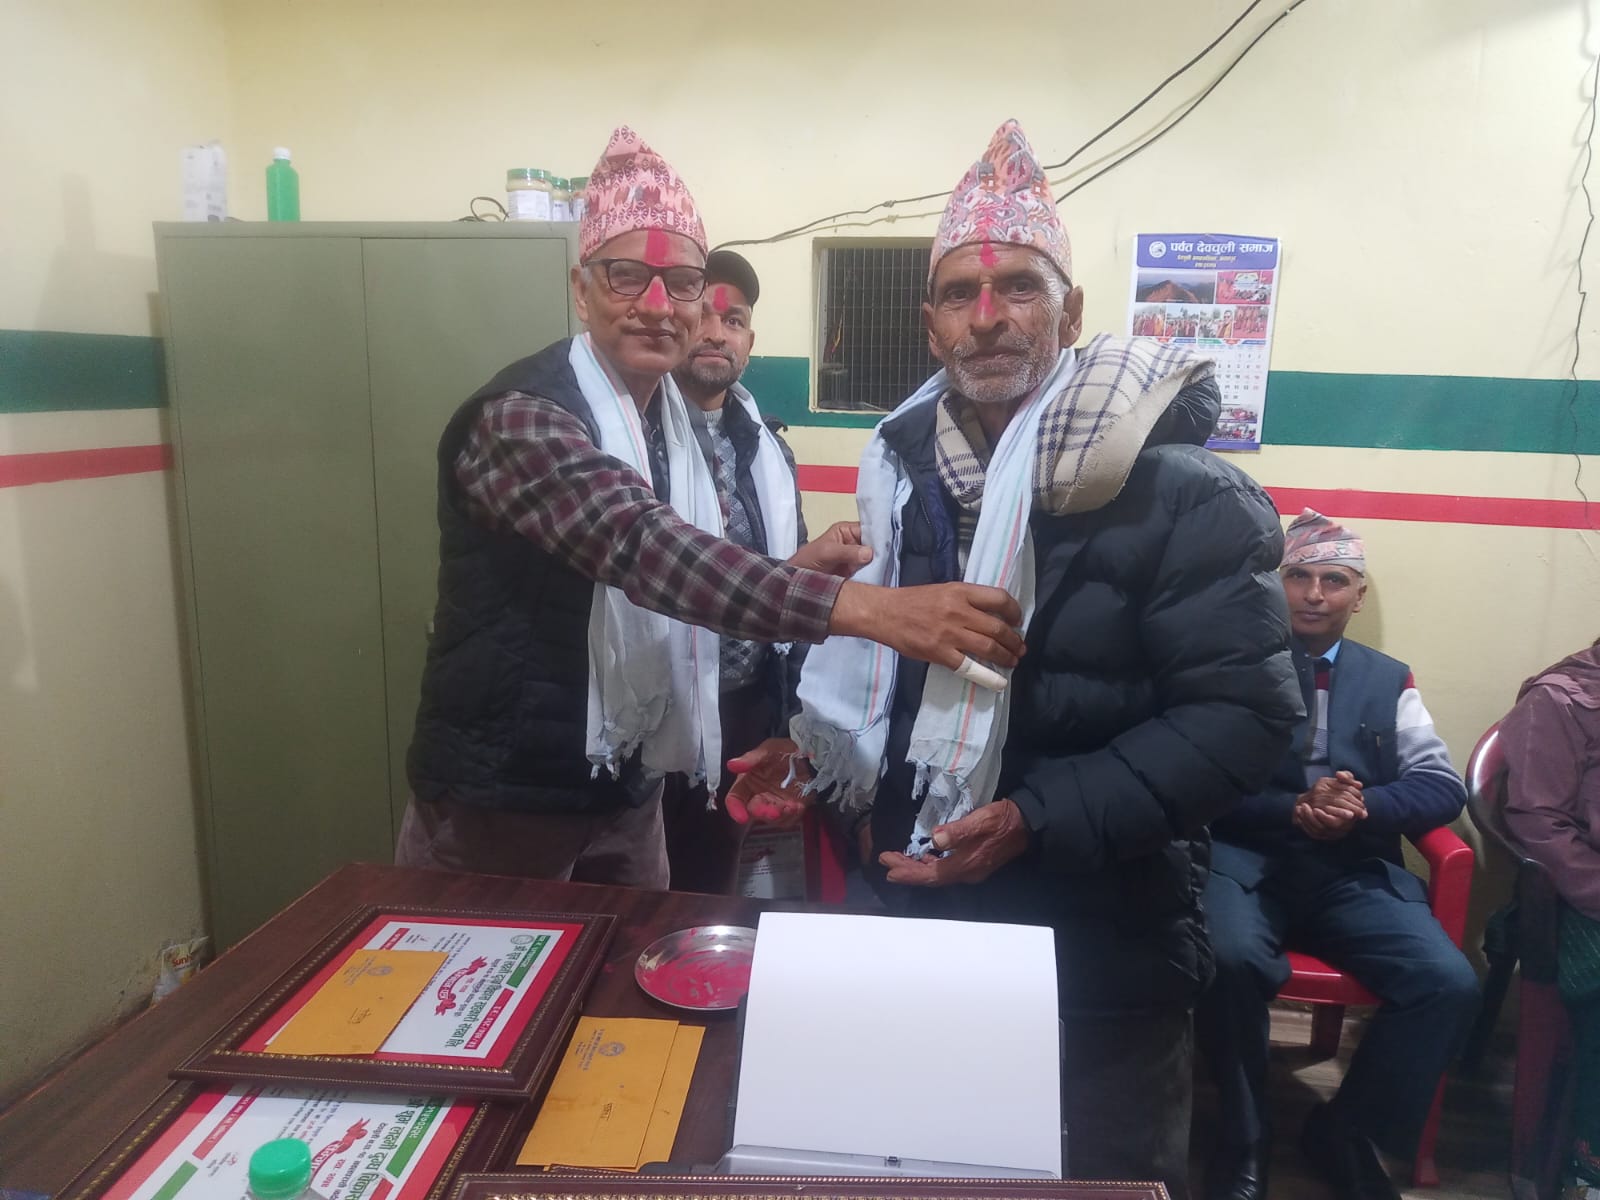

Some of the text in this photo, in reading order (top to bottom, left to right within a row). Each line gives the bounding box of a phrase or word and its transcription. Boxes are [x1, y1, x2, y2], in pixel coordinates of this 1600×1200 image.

[1170, 240, 1273, 255] पर्वत देवचुली समाज
[464, 1002, 487, 1022] सहकारी
[395, 1110, 415, 1124] शुभ
[379, 1126, 404, 1149] लक्ष्मी
[365, 1152, 388, 1170] दुग्ध
